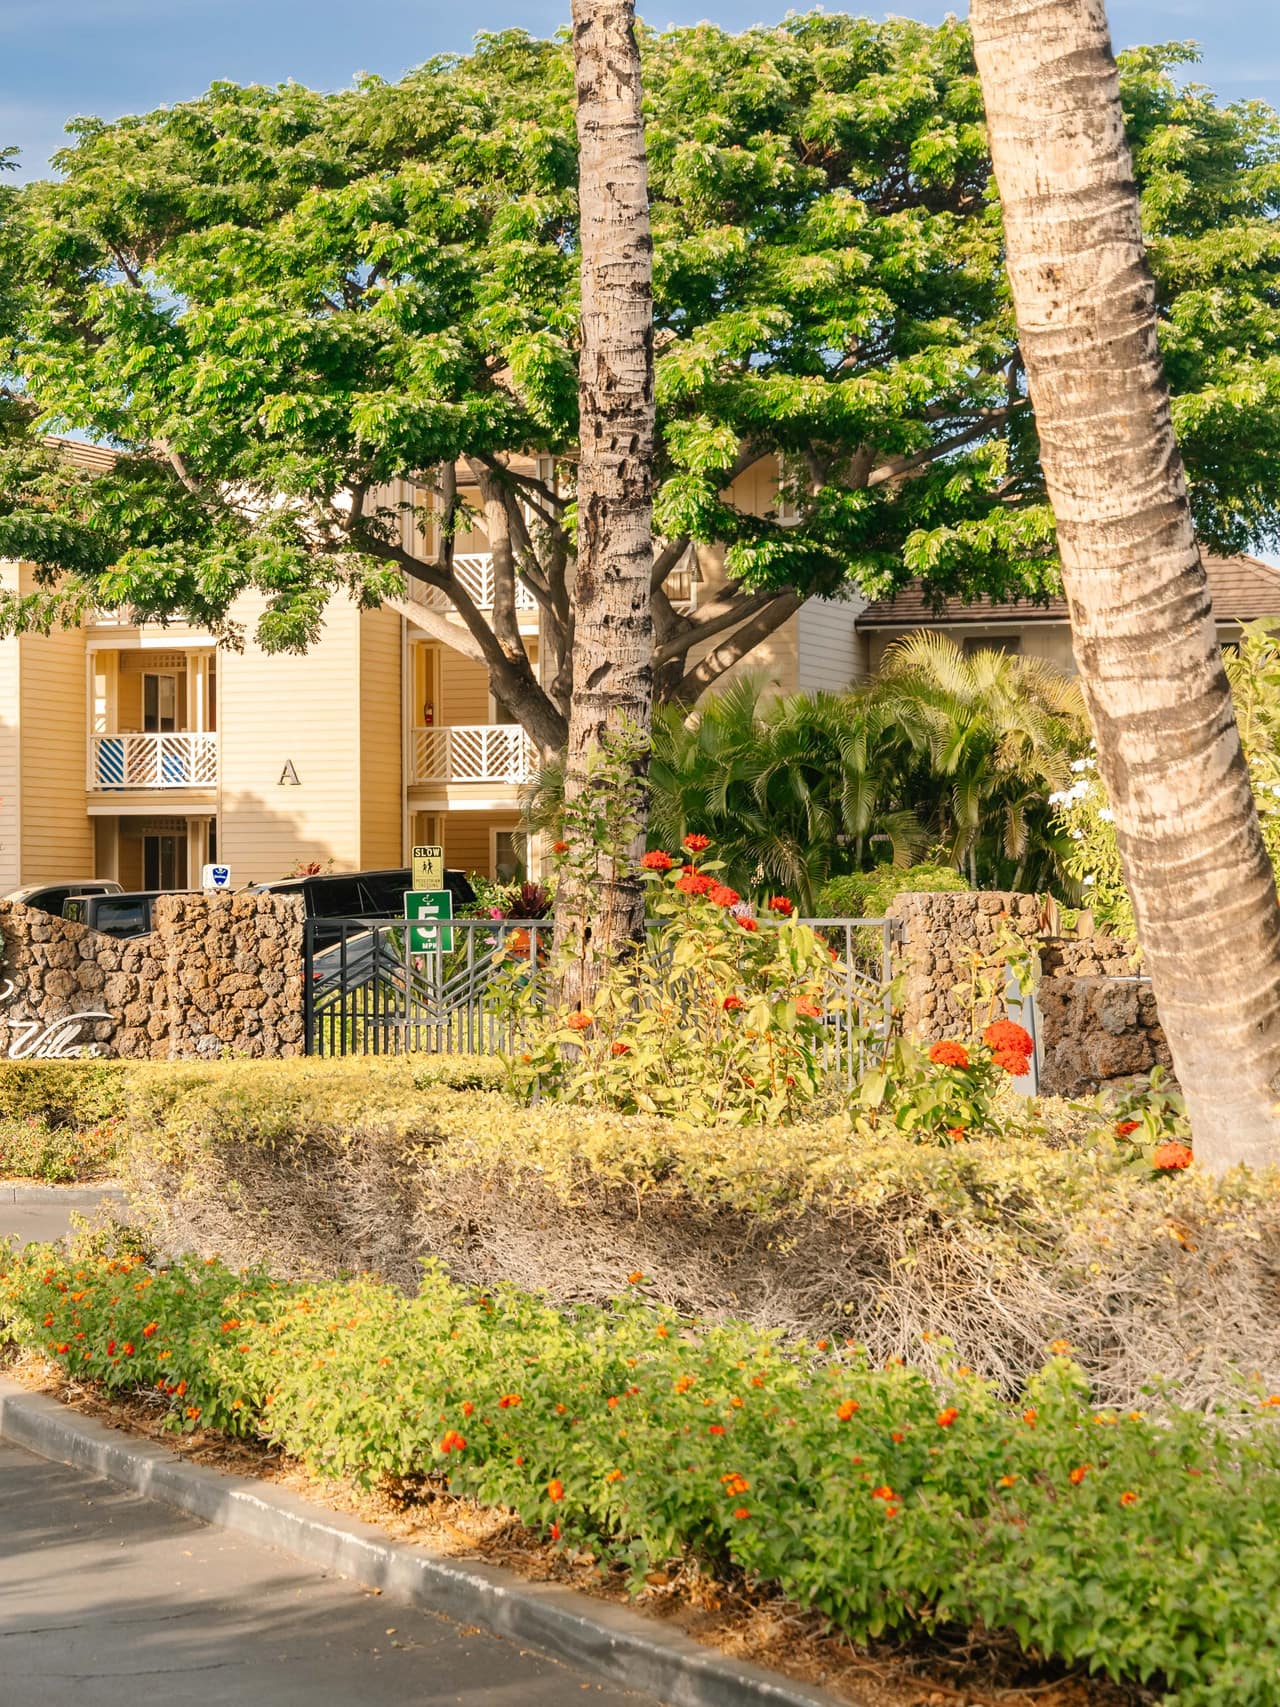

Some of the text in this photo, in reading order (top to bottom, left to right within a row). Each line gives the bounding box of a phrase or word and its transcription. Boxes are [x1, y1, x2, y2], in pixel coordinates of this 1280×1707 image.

[277, 758, 302, 785] A
[415, 848, 440, 857] SLOW
[416, 906, 440, 938] 5
